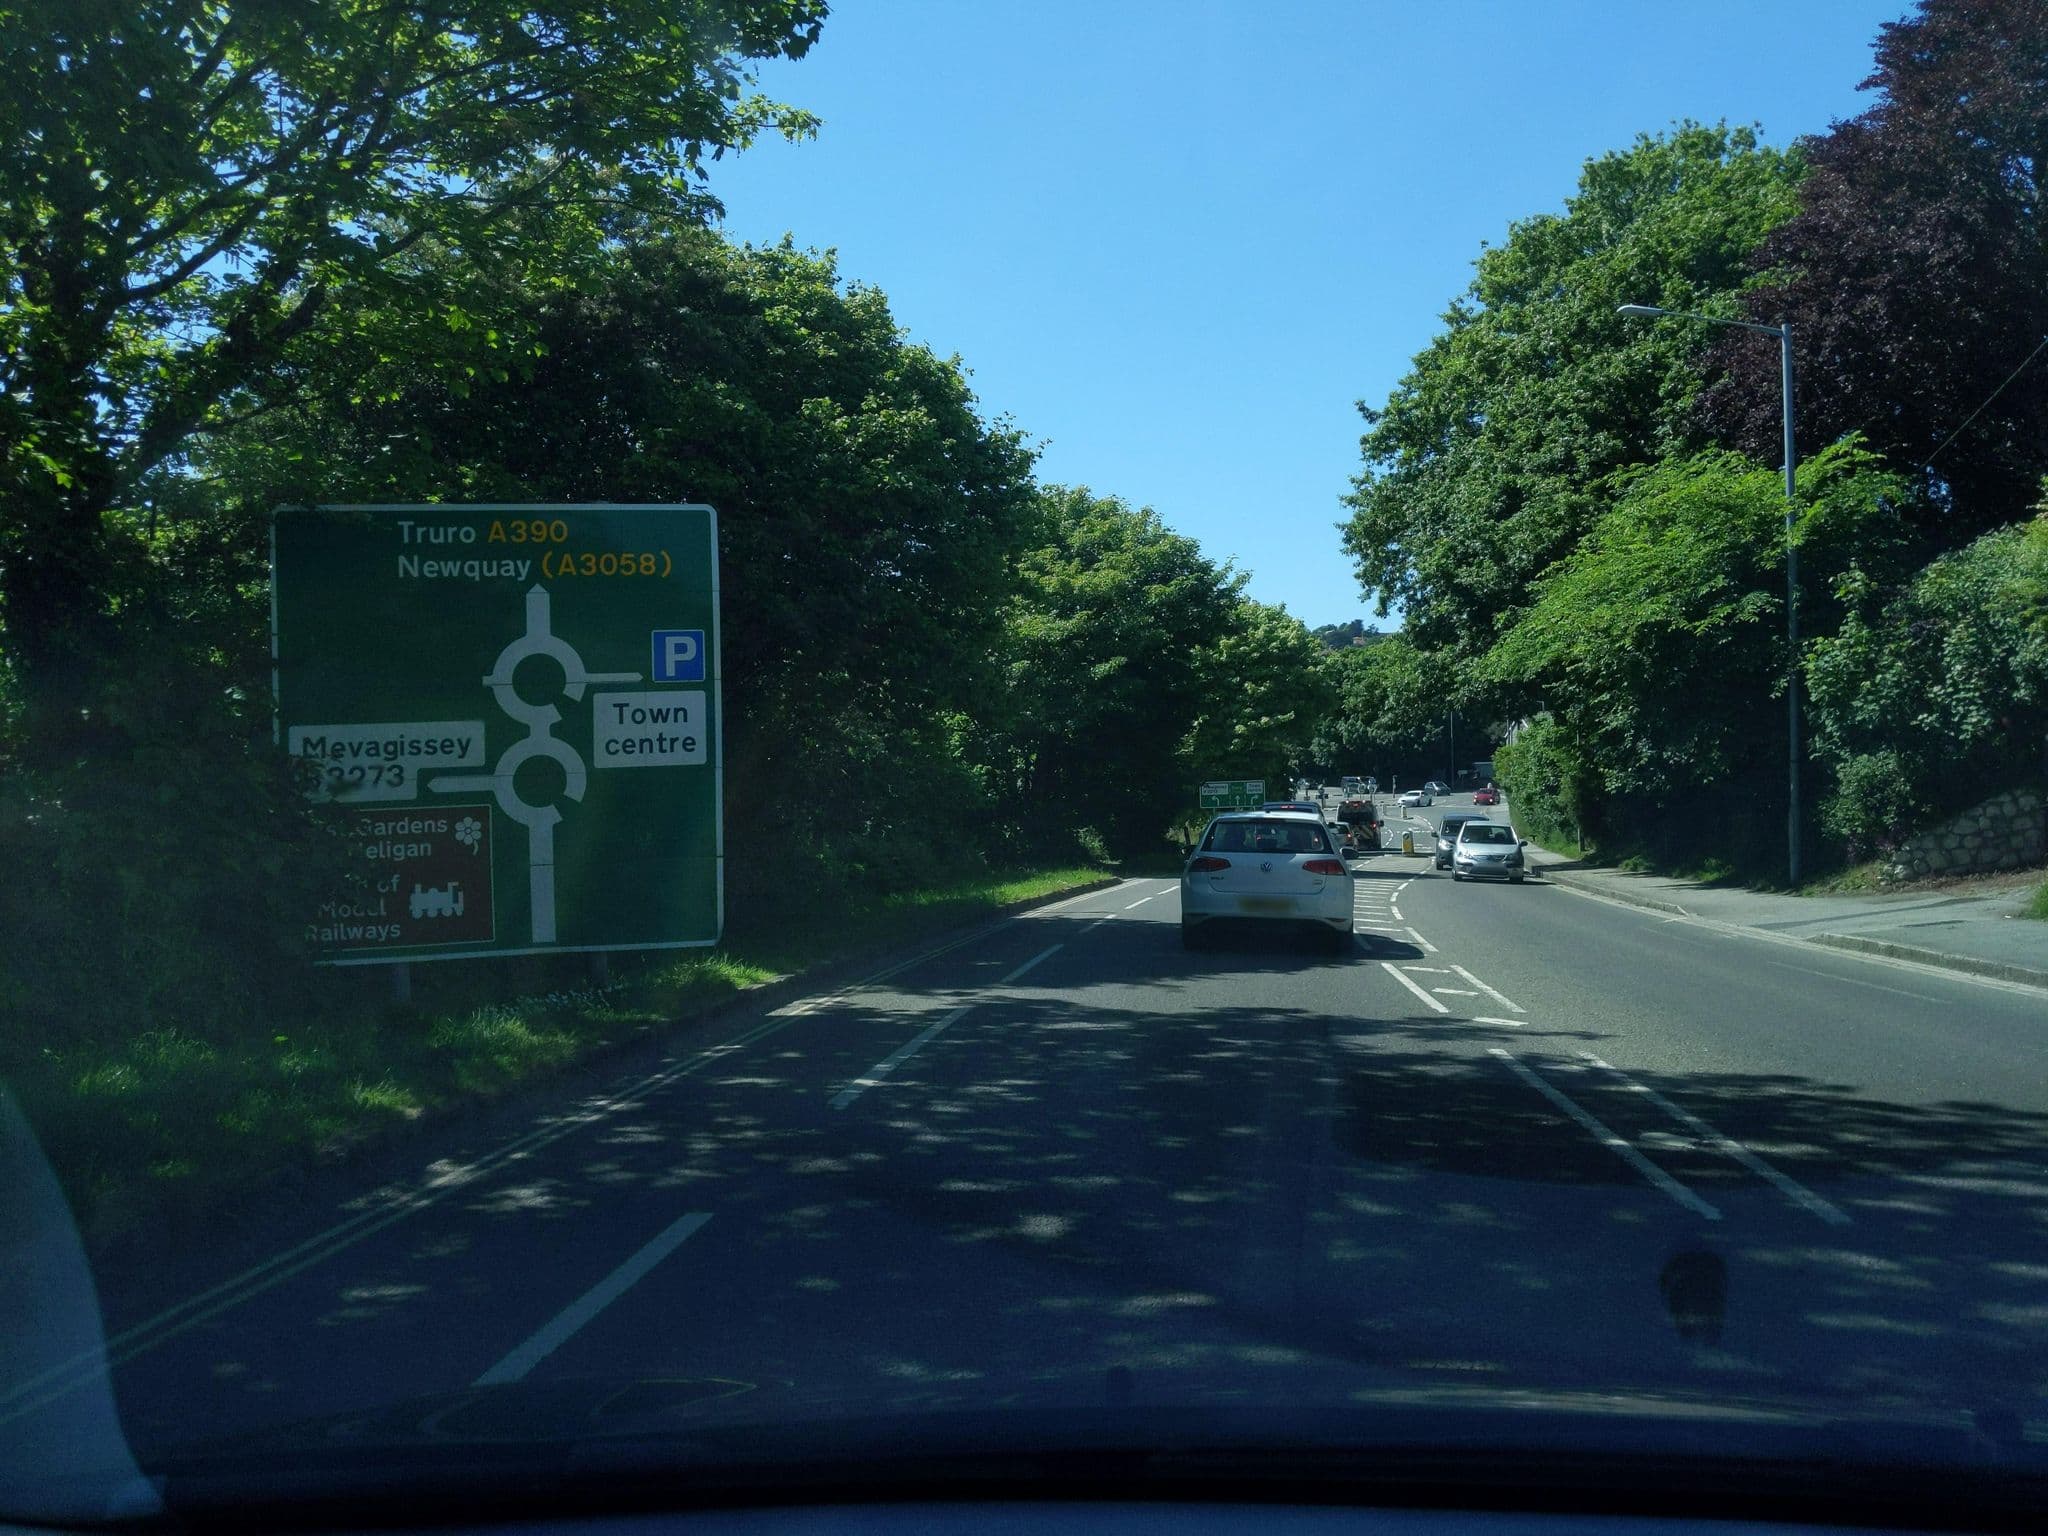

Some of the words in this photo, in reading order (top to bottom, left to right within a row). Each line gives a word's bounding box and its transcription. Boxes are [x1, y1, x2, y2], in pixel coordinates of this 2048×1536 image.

[398, 521, 476, 543] Truro
[487, 519, 569, 543] A390
[398, 555, 531, 581] Newquay
[541, 551, 672, 578] (A3058)
[665, 636, 697, 677] P
[612, 702, 688, 724] Town
[302, 734, 471, 761] Mevagissey
[605, 732, 697, 755] centre
[358, 841, 432, 861] eligan
